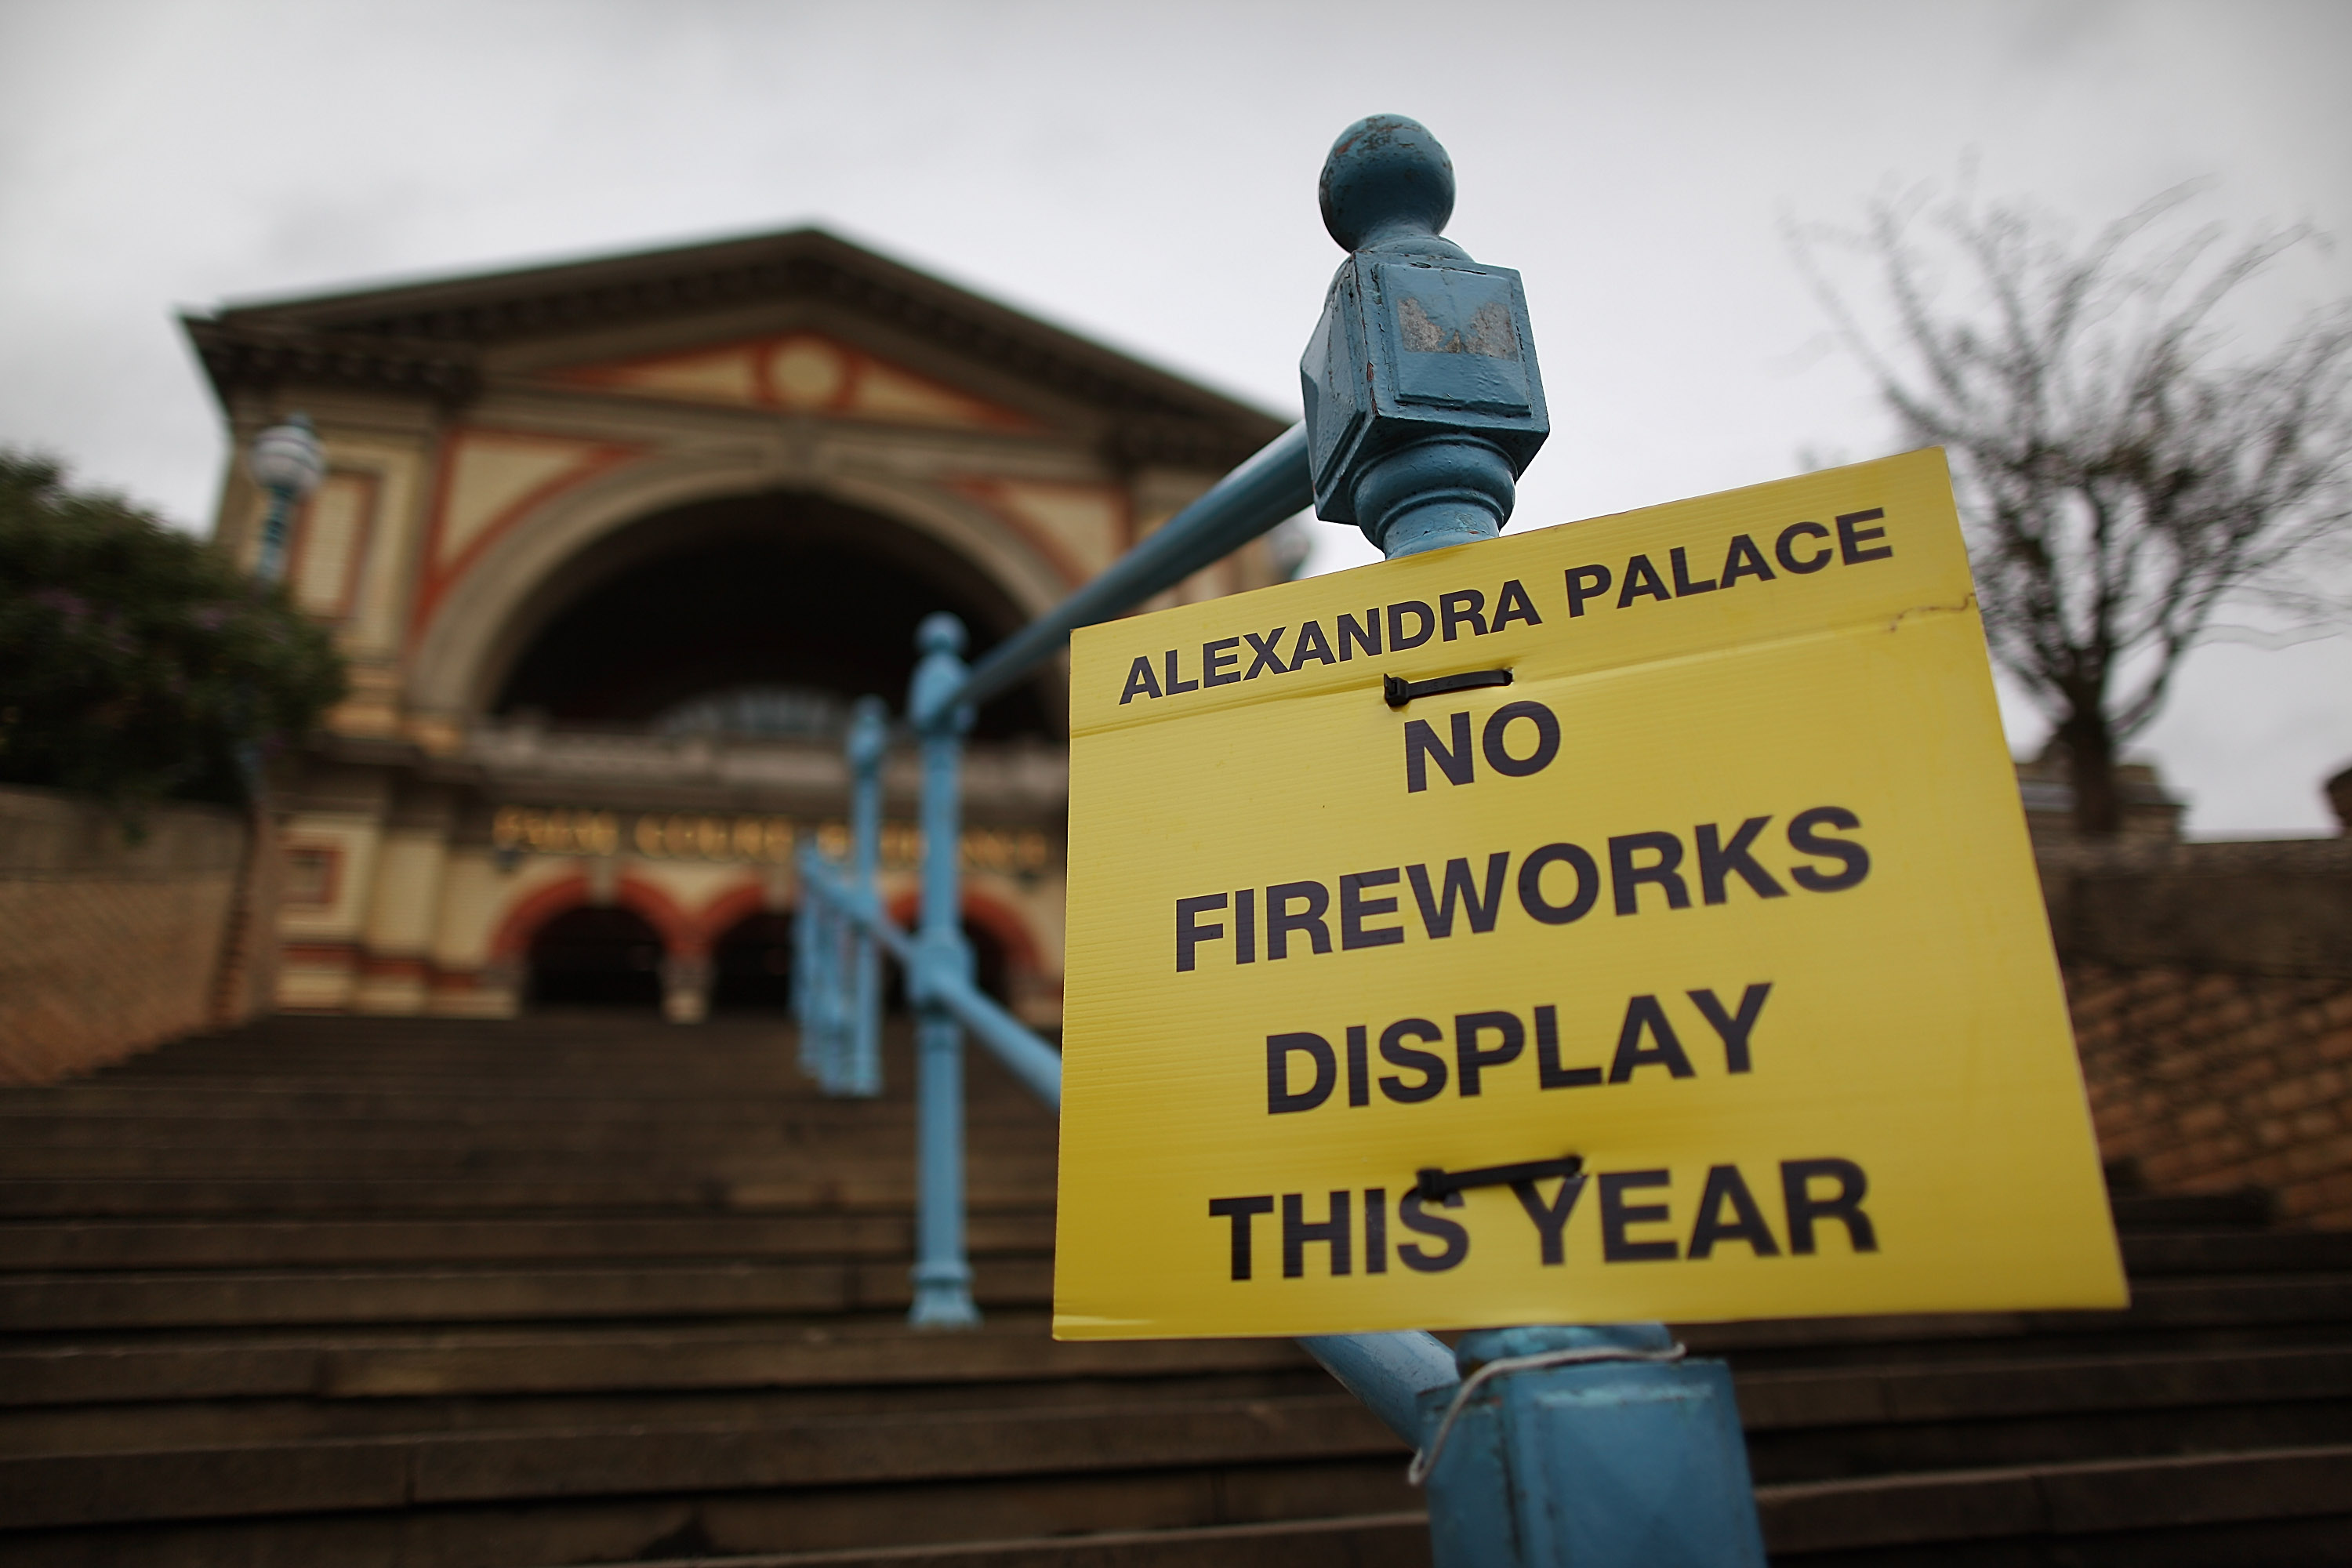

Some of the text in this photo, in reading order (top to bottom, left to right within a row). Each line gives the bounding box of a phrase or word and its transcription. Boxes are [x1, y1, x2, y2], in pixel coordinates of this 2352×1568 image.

[1118, 506, 1894, 706] ALEXANDRA PALACE
[1404, 700, 1561, 793] NO
[1175, 805, 1870, 973] FIREWORKS
[1266, 982, 1773, 1116] DISPLAY
[1208, 1156, 1879, 1282] THIS YEAR
